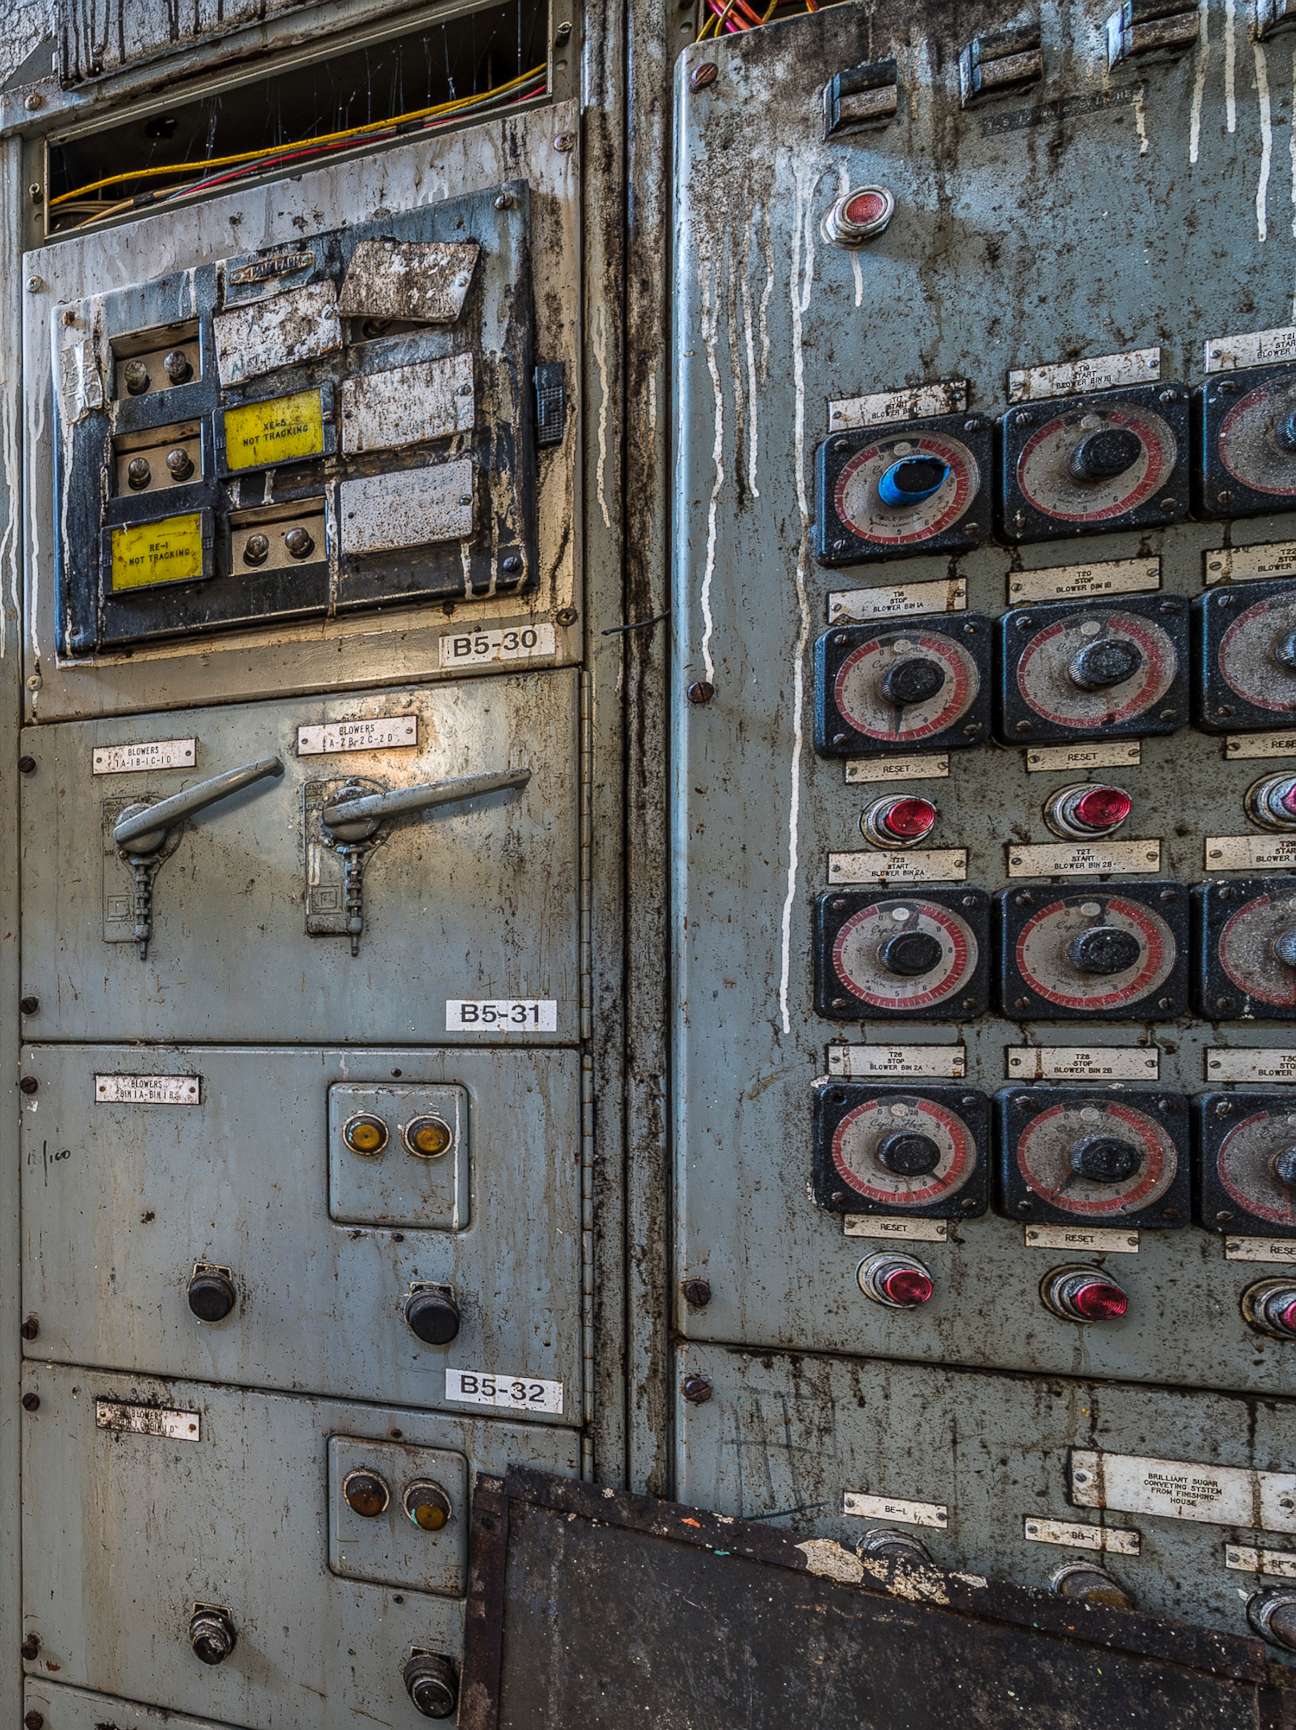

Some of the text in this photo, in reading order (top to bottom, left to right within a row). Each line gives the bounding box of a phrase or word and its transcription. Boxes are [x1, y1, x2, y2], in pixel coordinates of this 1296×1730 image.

[1275, 340, 1296, 349] STAR
[1257, 348, 1290, 359] BLOWER
[1073, 371, 1096, 380] START
[243, 426, 309, 447] NOT TRACKING
[129, 548, 190, 565] NOT TRACKING
[1258, 563, 1292, 573] BLOWER
[1074, 576, 1094, 584] STOP
[1056, 584, 1088, 593] BLOWER
[890, 596, 907, 604] STOP
[873, 604, 903, 613] BLOWER
[453, 630, 538, 658] B5-30
[339, 724, 375, 736] BLOWERS
[1271, 740, 1296, 749] RESE
[127, 746, 159, 756] BLOWERS
[1067, 752, 1098, 761] RESET
[883, 765, 911, 774] RESET
[1275, 847, 1296, 855] STAR
[1256, 855, 1289, 863] BLOWER
[1054, 861, 1086, 870] BLOWER
[871, 869, 900, 877] BLOWER
[460, 1004, 540, 1025] B5-31
[870, 1063, 899, 1071] BLOWER
[1054, 1066, 1086, 1074] BLOWER
[1258, 1069, 1292, 1077] BLOWER
[131, 1079, 162, 1089] BLOWERS
[880, 1223, 908, 1232] RESET
[1064, 1234, 1095, 1243] RESET
[1270, 1246, 1296, 1256] RESE
[460, 1374, 545, 1403] B5-32
[1148, 1472, 1219, 1488] BRILLIANT SUGAR
[1150, 1487, 1174, 1496] FROM
[1191, 1485, 1223, 1496] SYSTEM
[1170, 1498, 1198, 1507] HOUSE
